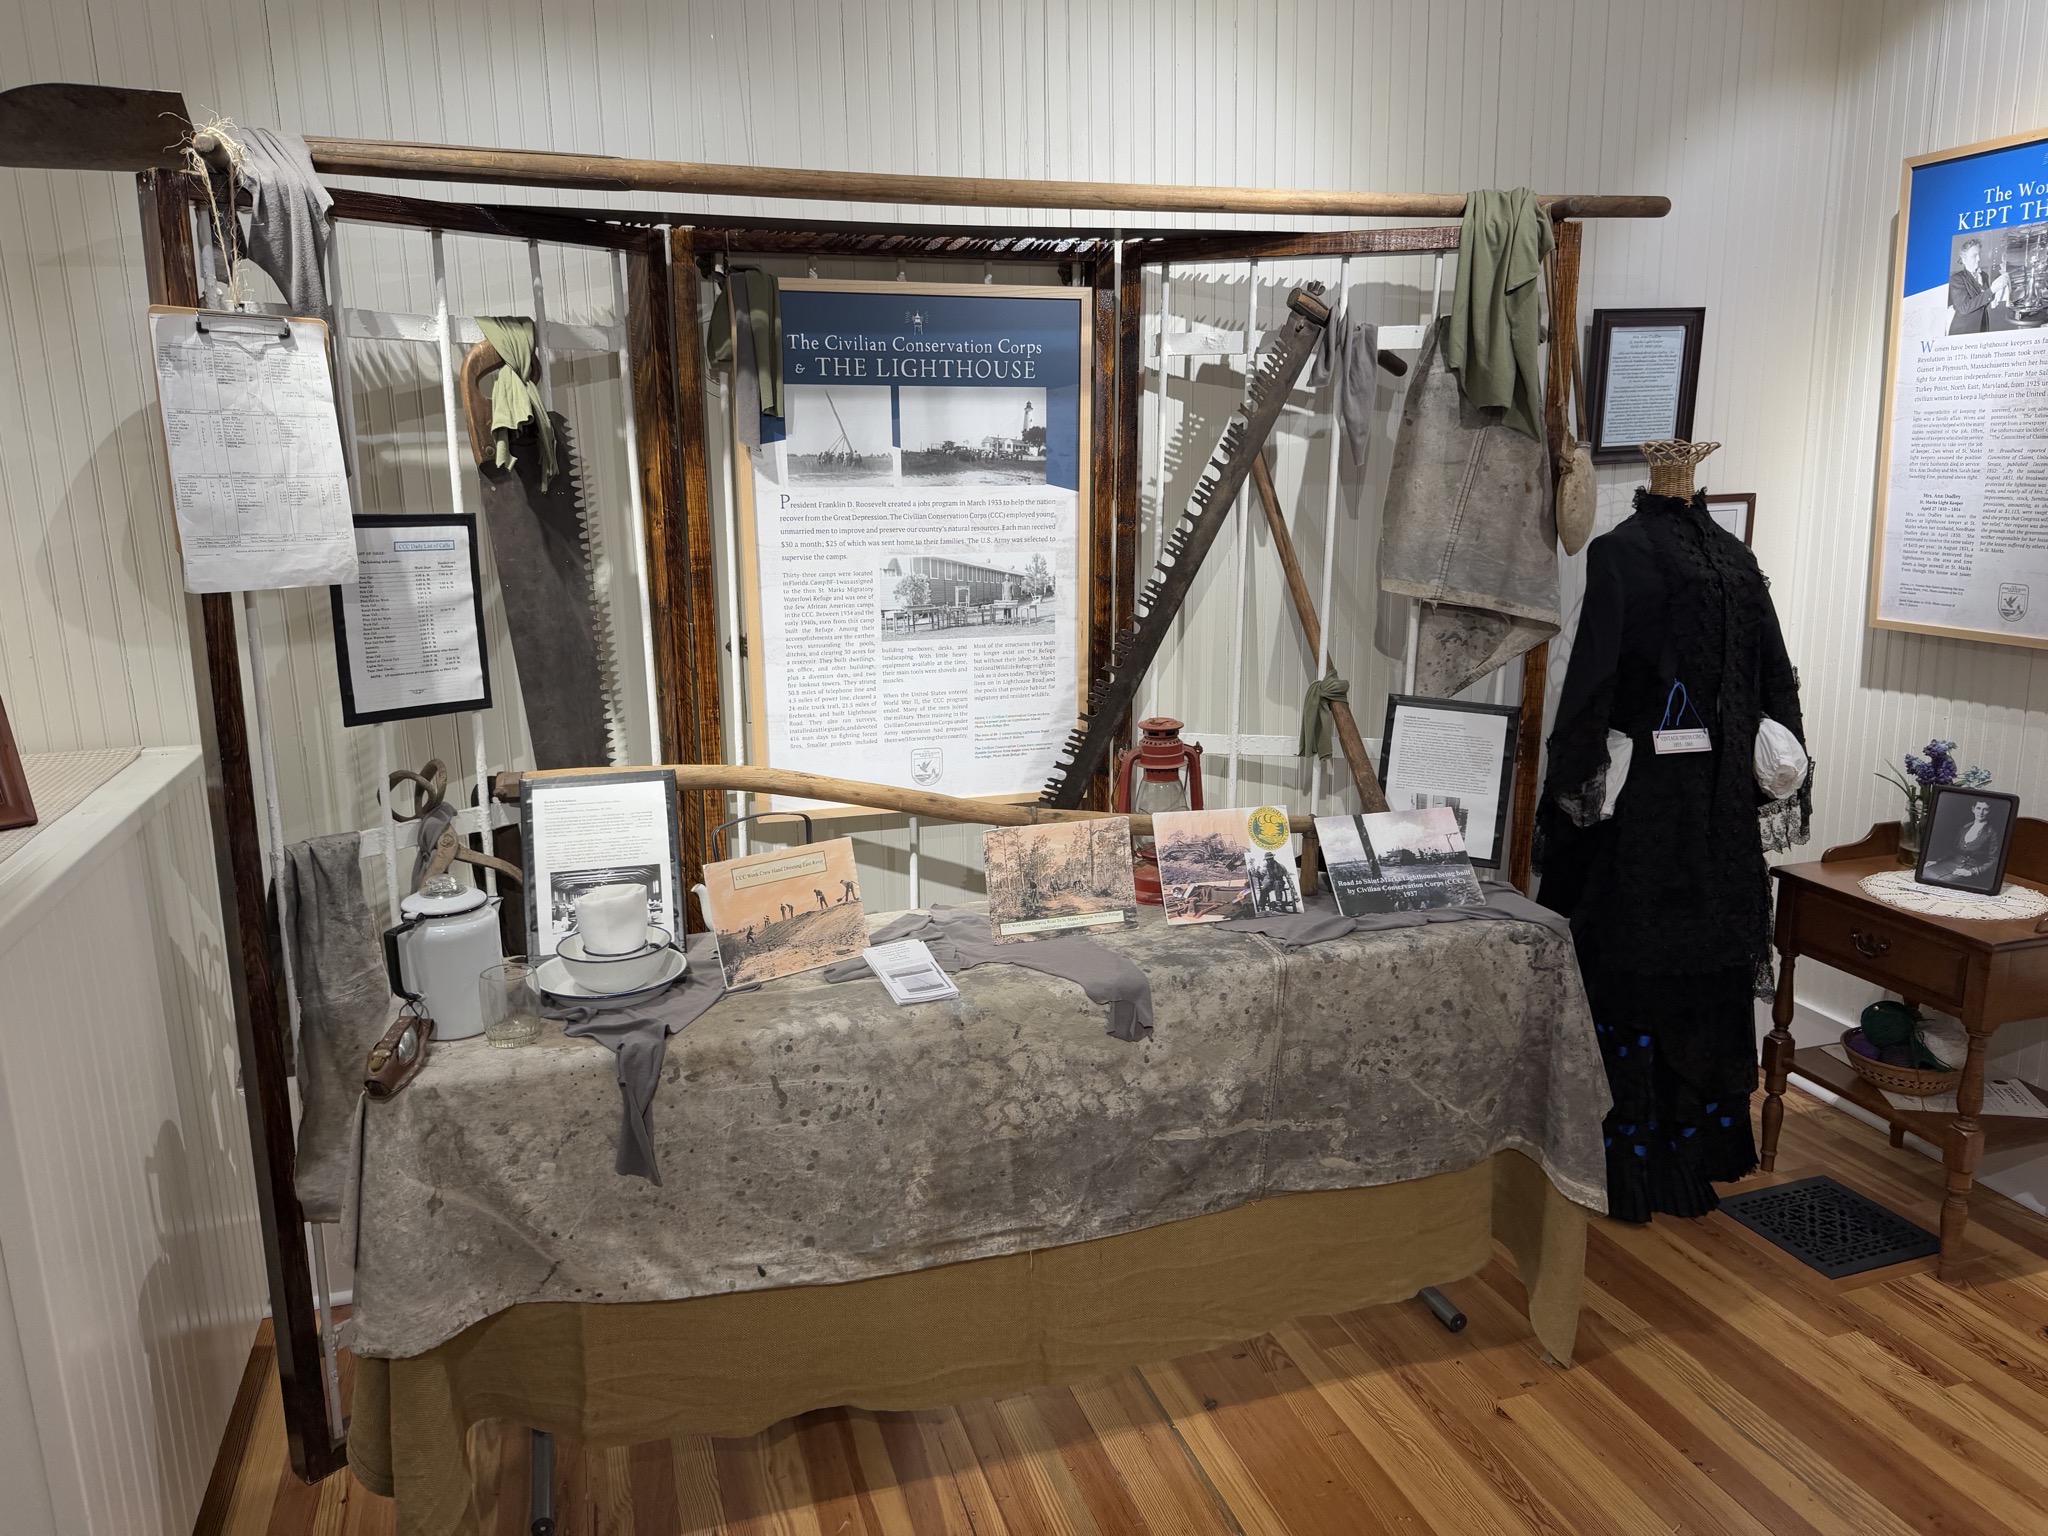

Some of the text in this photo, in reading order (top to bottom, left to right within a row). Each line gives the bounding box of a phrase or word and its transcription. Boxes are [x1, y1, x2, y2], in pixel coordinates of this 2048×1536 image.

[1984, 181, 2048, 204] The Wo
[1958, 204, 2012, 231] KEPT
[787, 333, 1042, 358] The Civilian Conservation Corps
[1980, 341, 2009, 349] lighthouse
[795, 357, 1036, 379] & THE LIGHTHOUSE
[1942, 364, 1969, 372] Plymouth,
[1979, 392, 2007, 400] lighthouse
[780, 494, 817, 509] President
[918, 500, 930, 508] jobs
[1011, 499, 1024, 507] help
[852, 514, 889, 522] Depression.
[970, 512, 987, 520] Corps
[988, 511, 1006, 519] (CCC)
[1007, 511, 1035, 519] employed
[1036, 511, 1056, 519] young,
[782, 554, 812, 562] supervise
[1258, 813, 1278, 824] CCC
[1402, 874, 1437, 882] Lighthouse
[1382, 883, 1424, 891] Conservation
[1445, 878, 1466, 886] (CCC)
